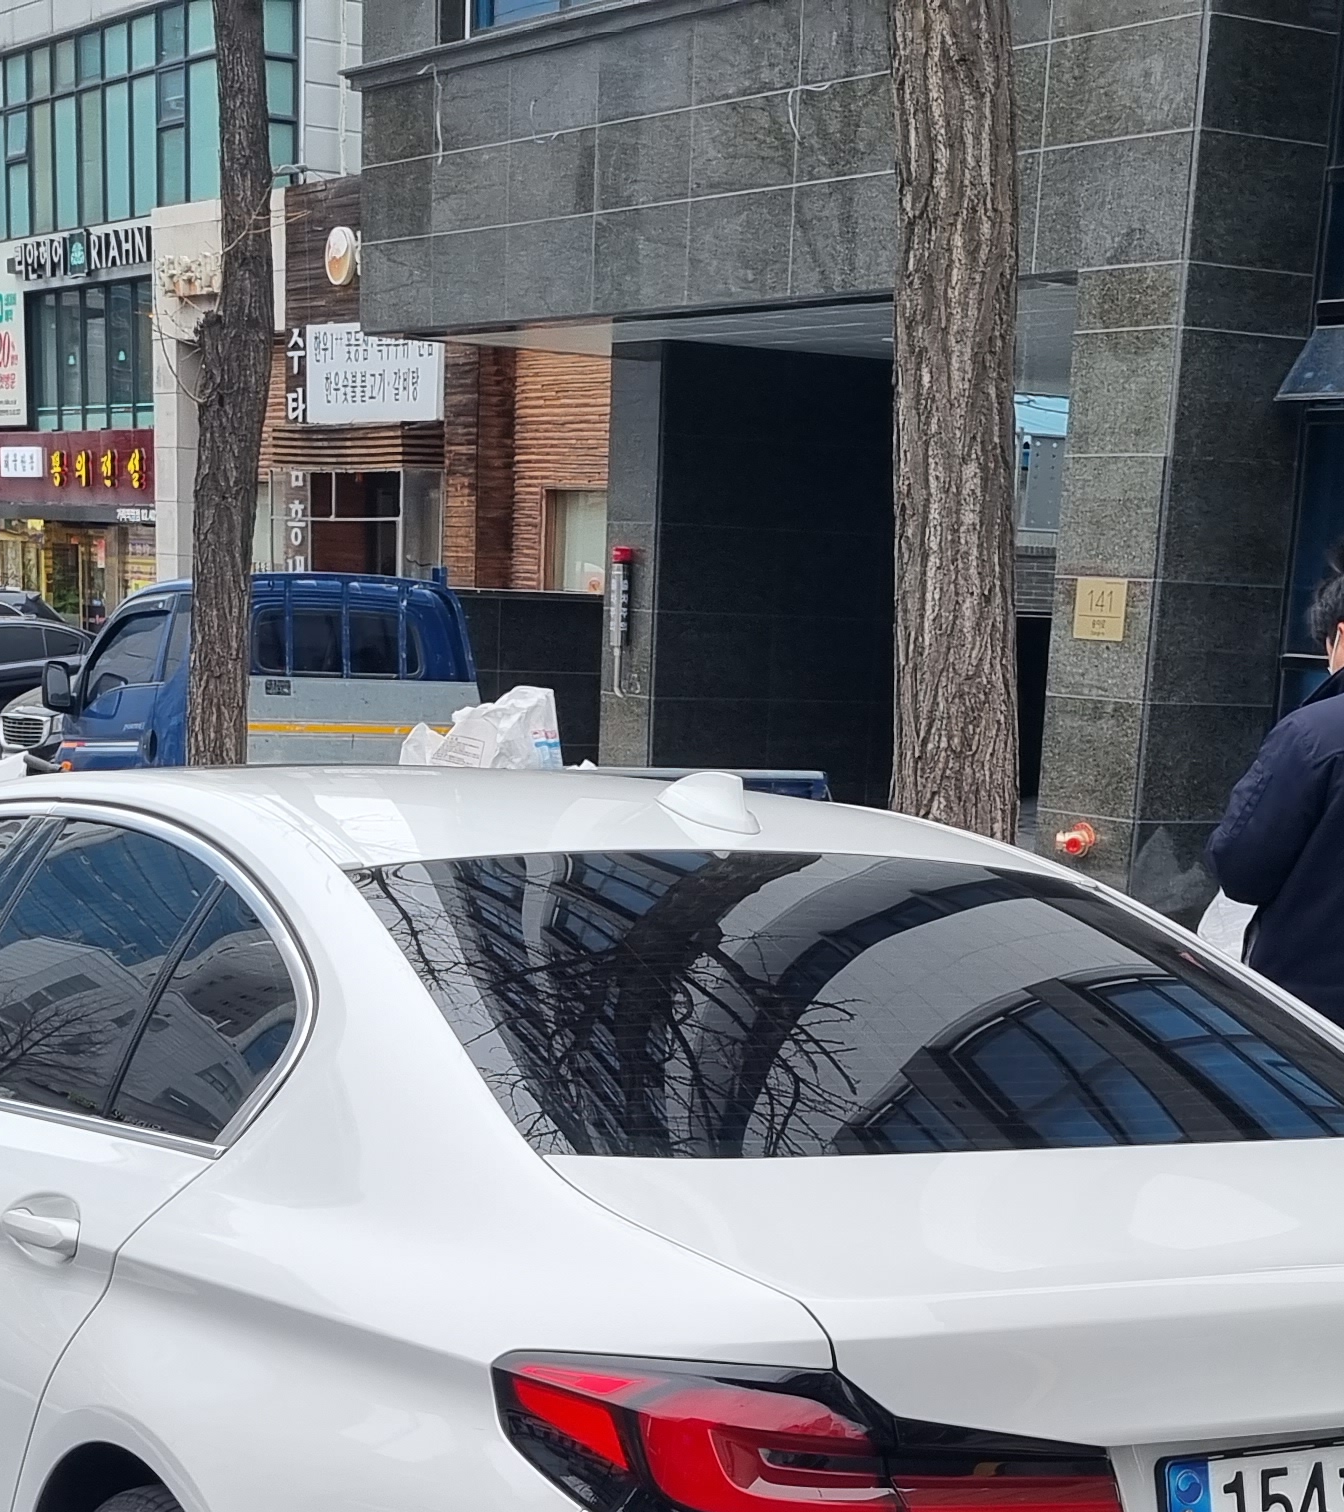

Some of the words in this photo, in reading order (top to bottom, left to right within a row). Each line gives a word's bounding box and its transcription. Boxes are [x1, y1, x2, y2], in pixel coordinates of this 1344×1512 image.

[90, 226, 147, 270] RIAHN
[51, 448, 140, 489] 뽕의전설
[1087, 589, 1114, 614] 141
